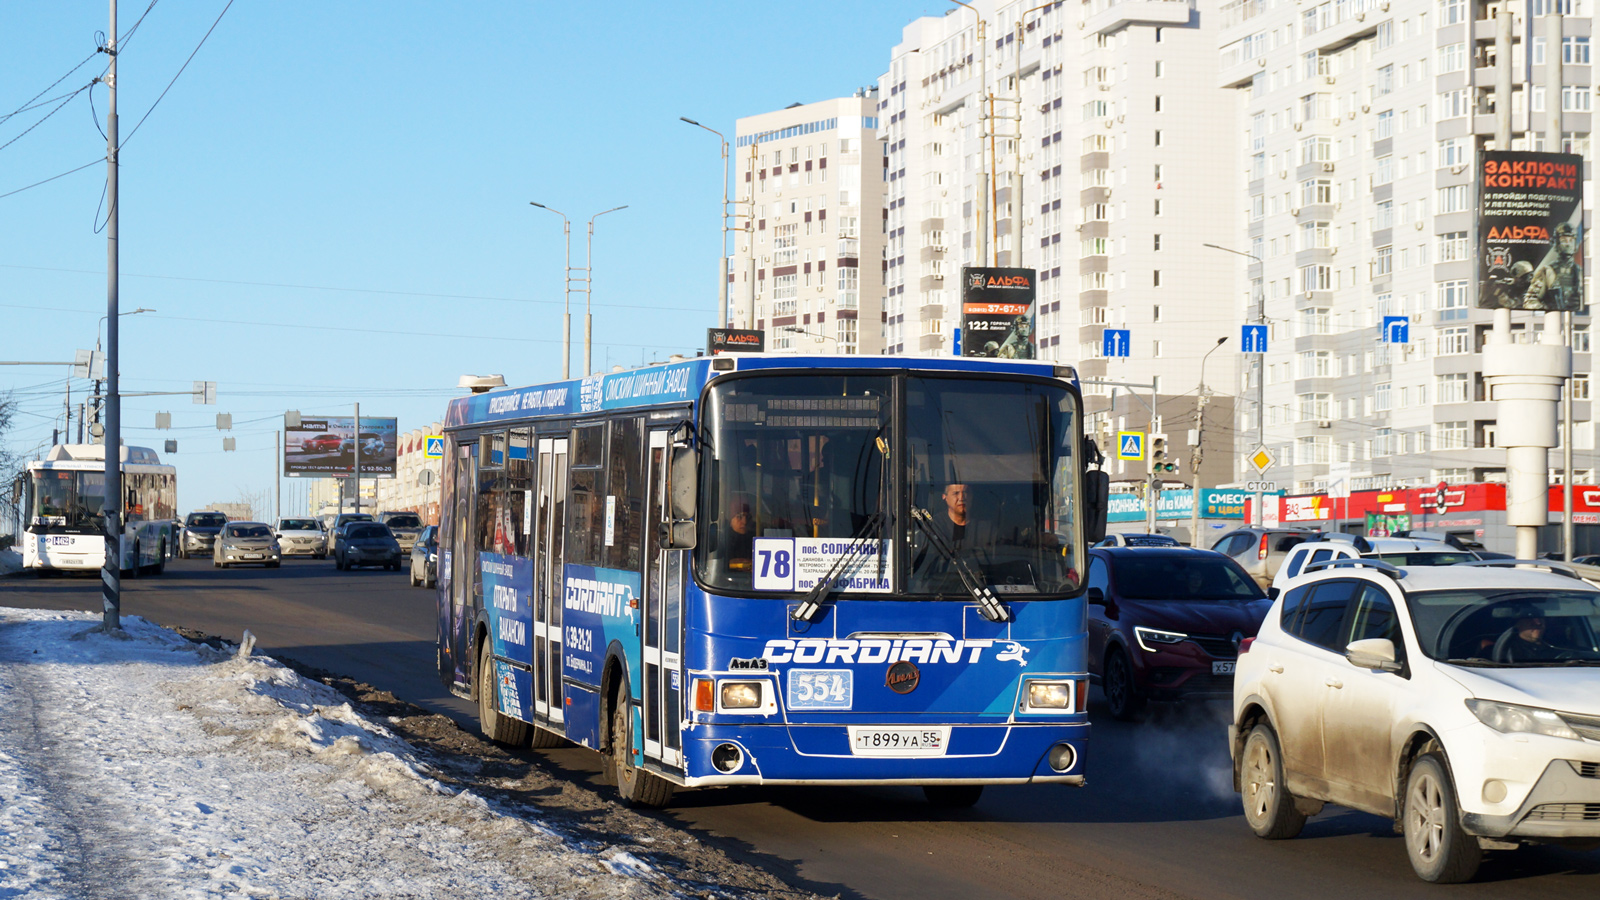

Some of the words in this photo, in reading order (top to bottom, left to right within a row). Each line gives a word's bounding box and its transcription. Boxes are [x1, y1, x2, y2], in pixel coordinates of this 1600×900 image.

[1484, 160, 1576, 177] ЗАКЛЮЧИ
[1484, 174, 1576, 190] КОНТРАКТ
[1492, 192, 1527, 201] ПРОЙДИ
[1528, 193, 1574, 203] ПОДГОТОВКУ
[1491, 201, 1550, 209] ЛЕГЕНДАРНЫХ
[1487, 226, 1549, 240] АЛЬФА
[987, 276, 1030, 286] АЛЬФА
[988, 304, 1026, 313] 37-67-11
[968, 321, 989, 331] 122
[727, 334, 760, 344] АЛЬФА
[605, 371, 636, 401] ОМСКИЙ
[632, 365, 667, 397] ШИННЫЙ
[664, 367, 690, 398] ЗАВОД
[1247, 481, 1275, 491] СТОП
[1107, 498, 1139, 513] УХОННЫЕ
[1174, 495, 1194, 509] КАМН
[1208, 505, 1216, 513] в
[802, 546, 819, 554] пос.
[758, 550, 791, 578] 78
[799, 580, 815, 588] пос.
[493, 584, 517, 612] ОТКРЫТЫ
[565, 577, 625, 618] CORDIANT
[499, 616, 525, 646] ВАКАНСИИ
[570, 626, 592, 653] 39-21-21
[760, 639, 994, 664] CORDIANT
[1215, 662, 1237, 672] Х57
[797, 674, 846, 701] 554
[923, 732, 937, 743] 55
